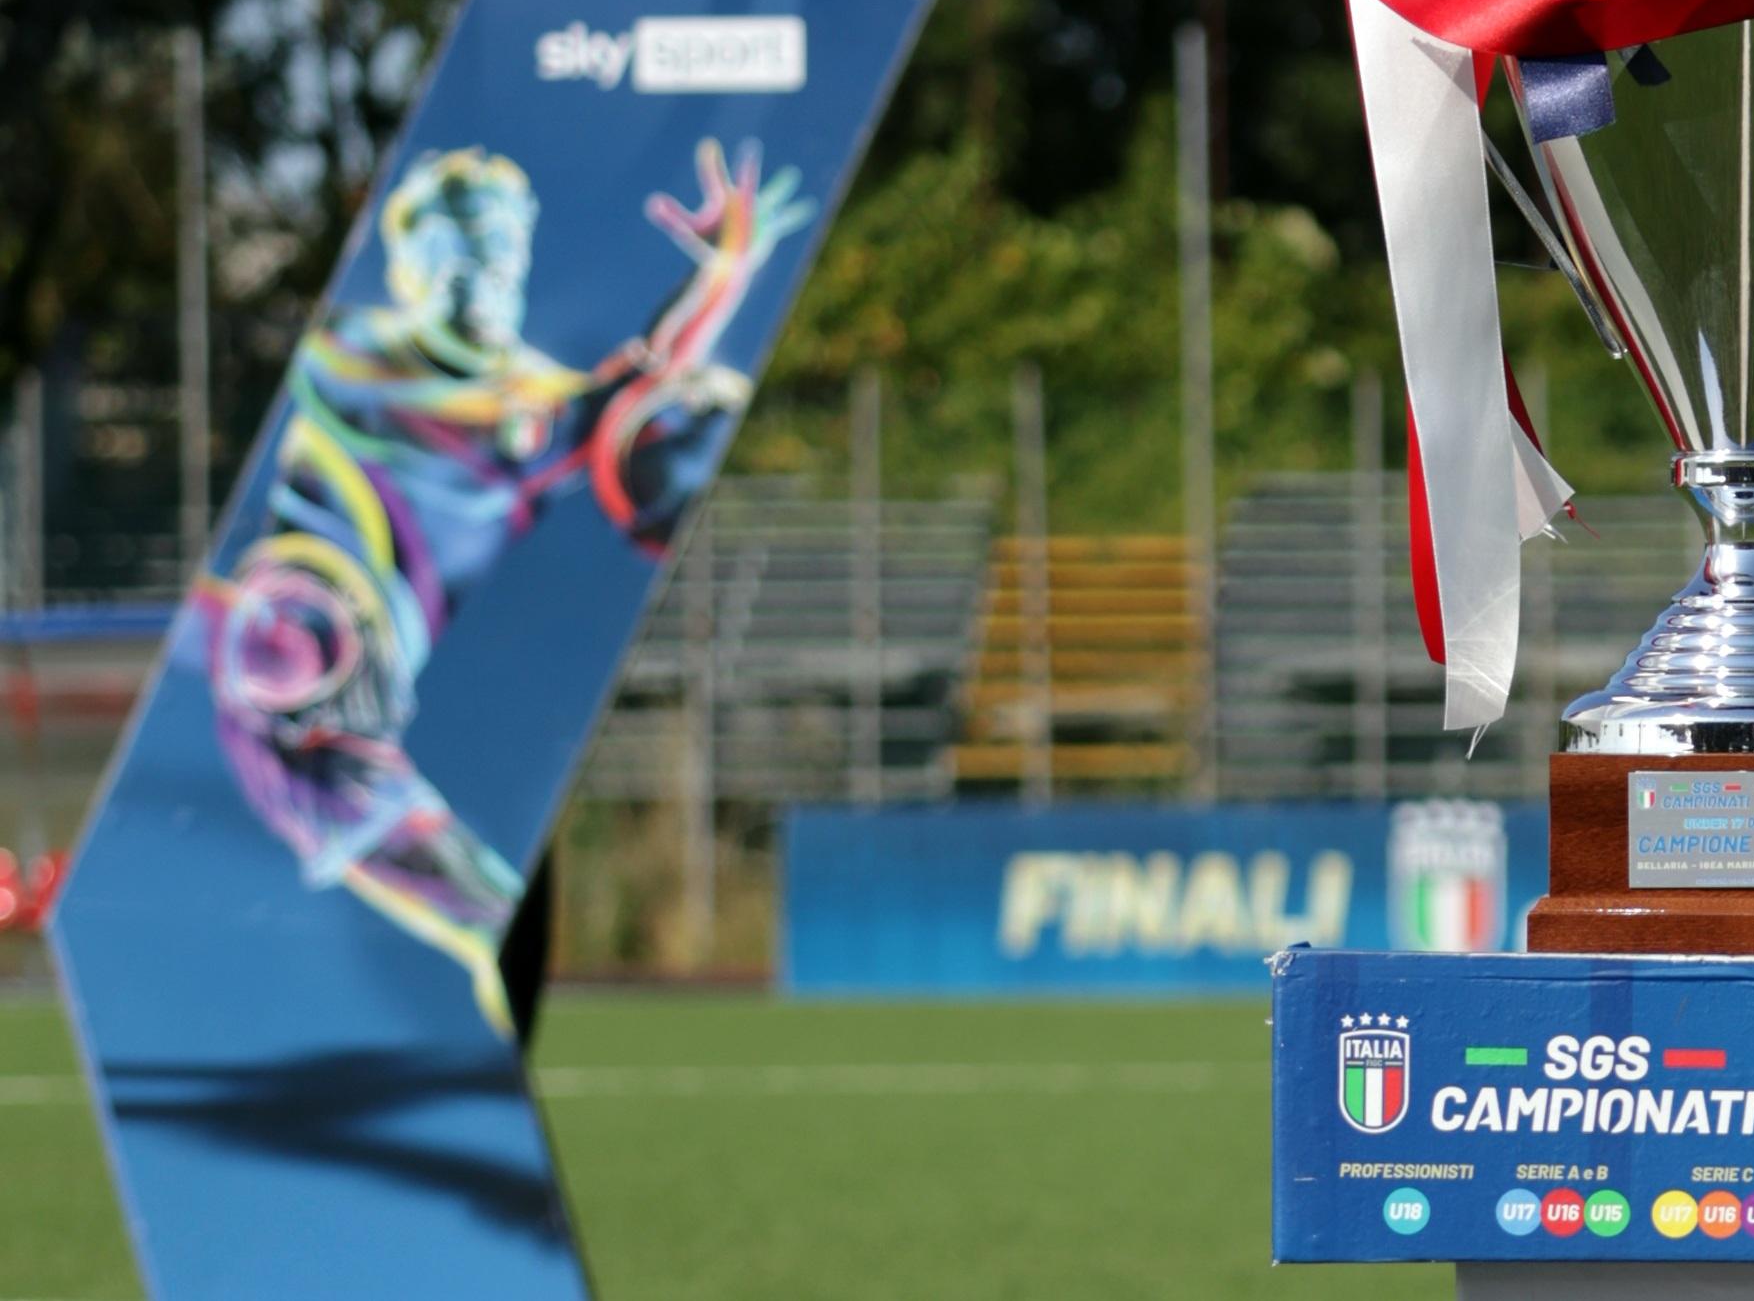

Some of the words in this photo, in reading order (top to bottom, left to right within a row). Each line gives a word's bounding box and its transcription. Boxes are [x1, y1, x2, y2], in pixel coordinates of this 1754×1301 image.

[536, 22, 633, 90] sky
[1692, 782, 1721, 793] SGS
[1662, 796, 1751, 809] CAMPIONATI
[1638, 835, 1752, 853] CAMPIONE
[1637, 861, 1688, 870] BELLARIA
[1000, 850, 1354, 958] FINALI
[1345, 1039, 1403, 1059] ITALIA
[1544, 1035, 1651, 1081] SGS
[1339, 1163, 1474, 1180] PROFESSIONISTI
[1516, 1165, 1564, 1180] SERIE
[1567, 1165, 1581, 1180] A
[1583, 1169, 1593, 1180] e
[1596, 1166, 1609, 1181] B
[1691, 1166, 1739, 1182] SERIE
[1742, 1167, 1754, 1182] C
[1388, 1202, 1423, 1220] U18
[1502, 1202, 1536, 1220] U17
[1546, 1203, 1580, 1221] U16
[1589, 1204, 1623, 1222] U15
[1659, 1204, 1692, 1222] U17
[1703, 1205, 1737, 1223] U16
